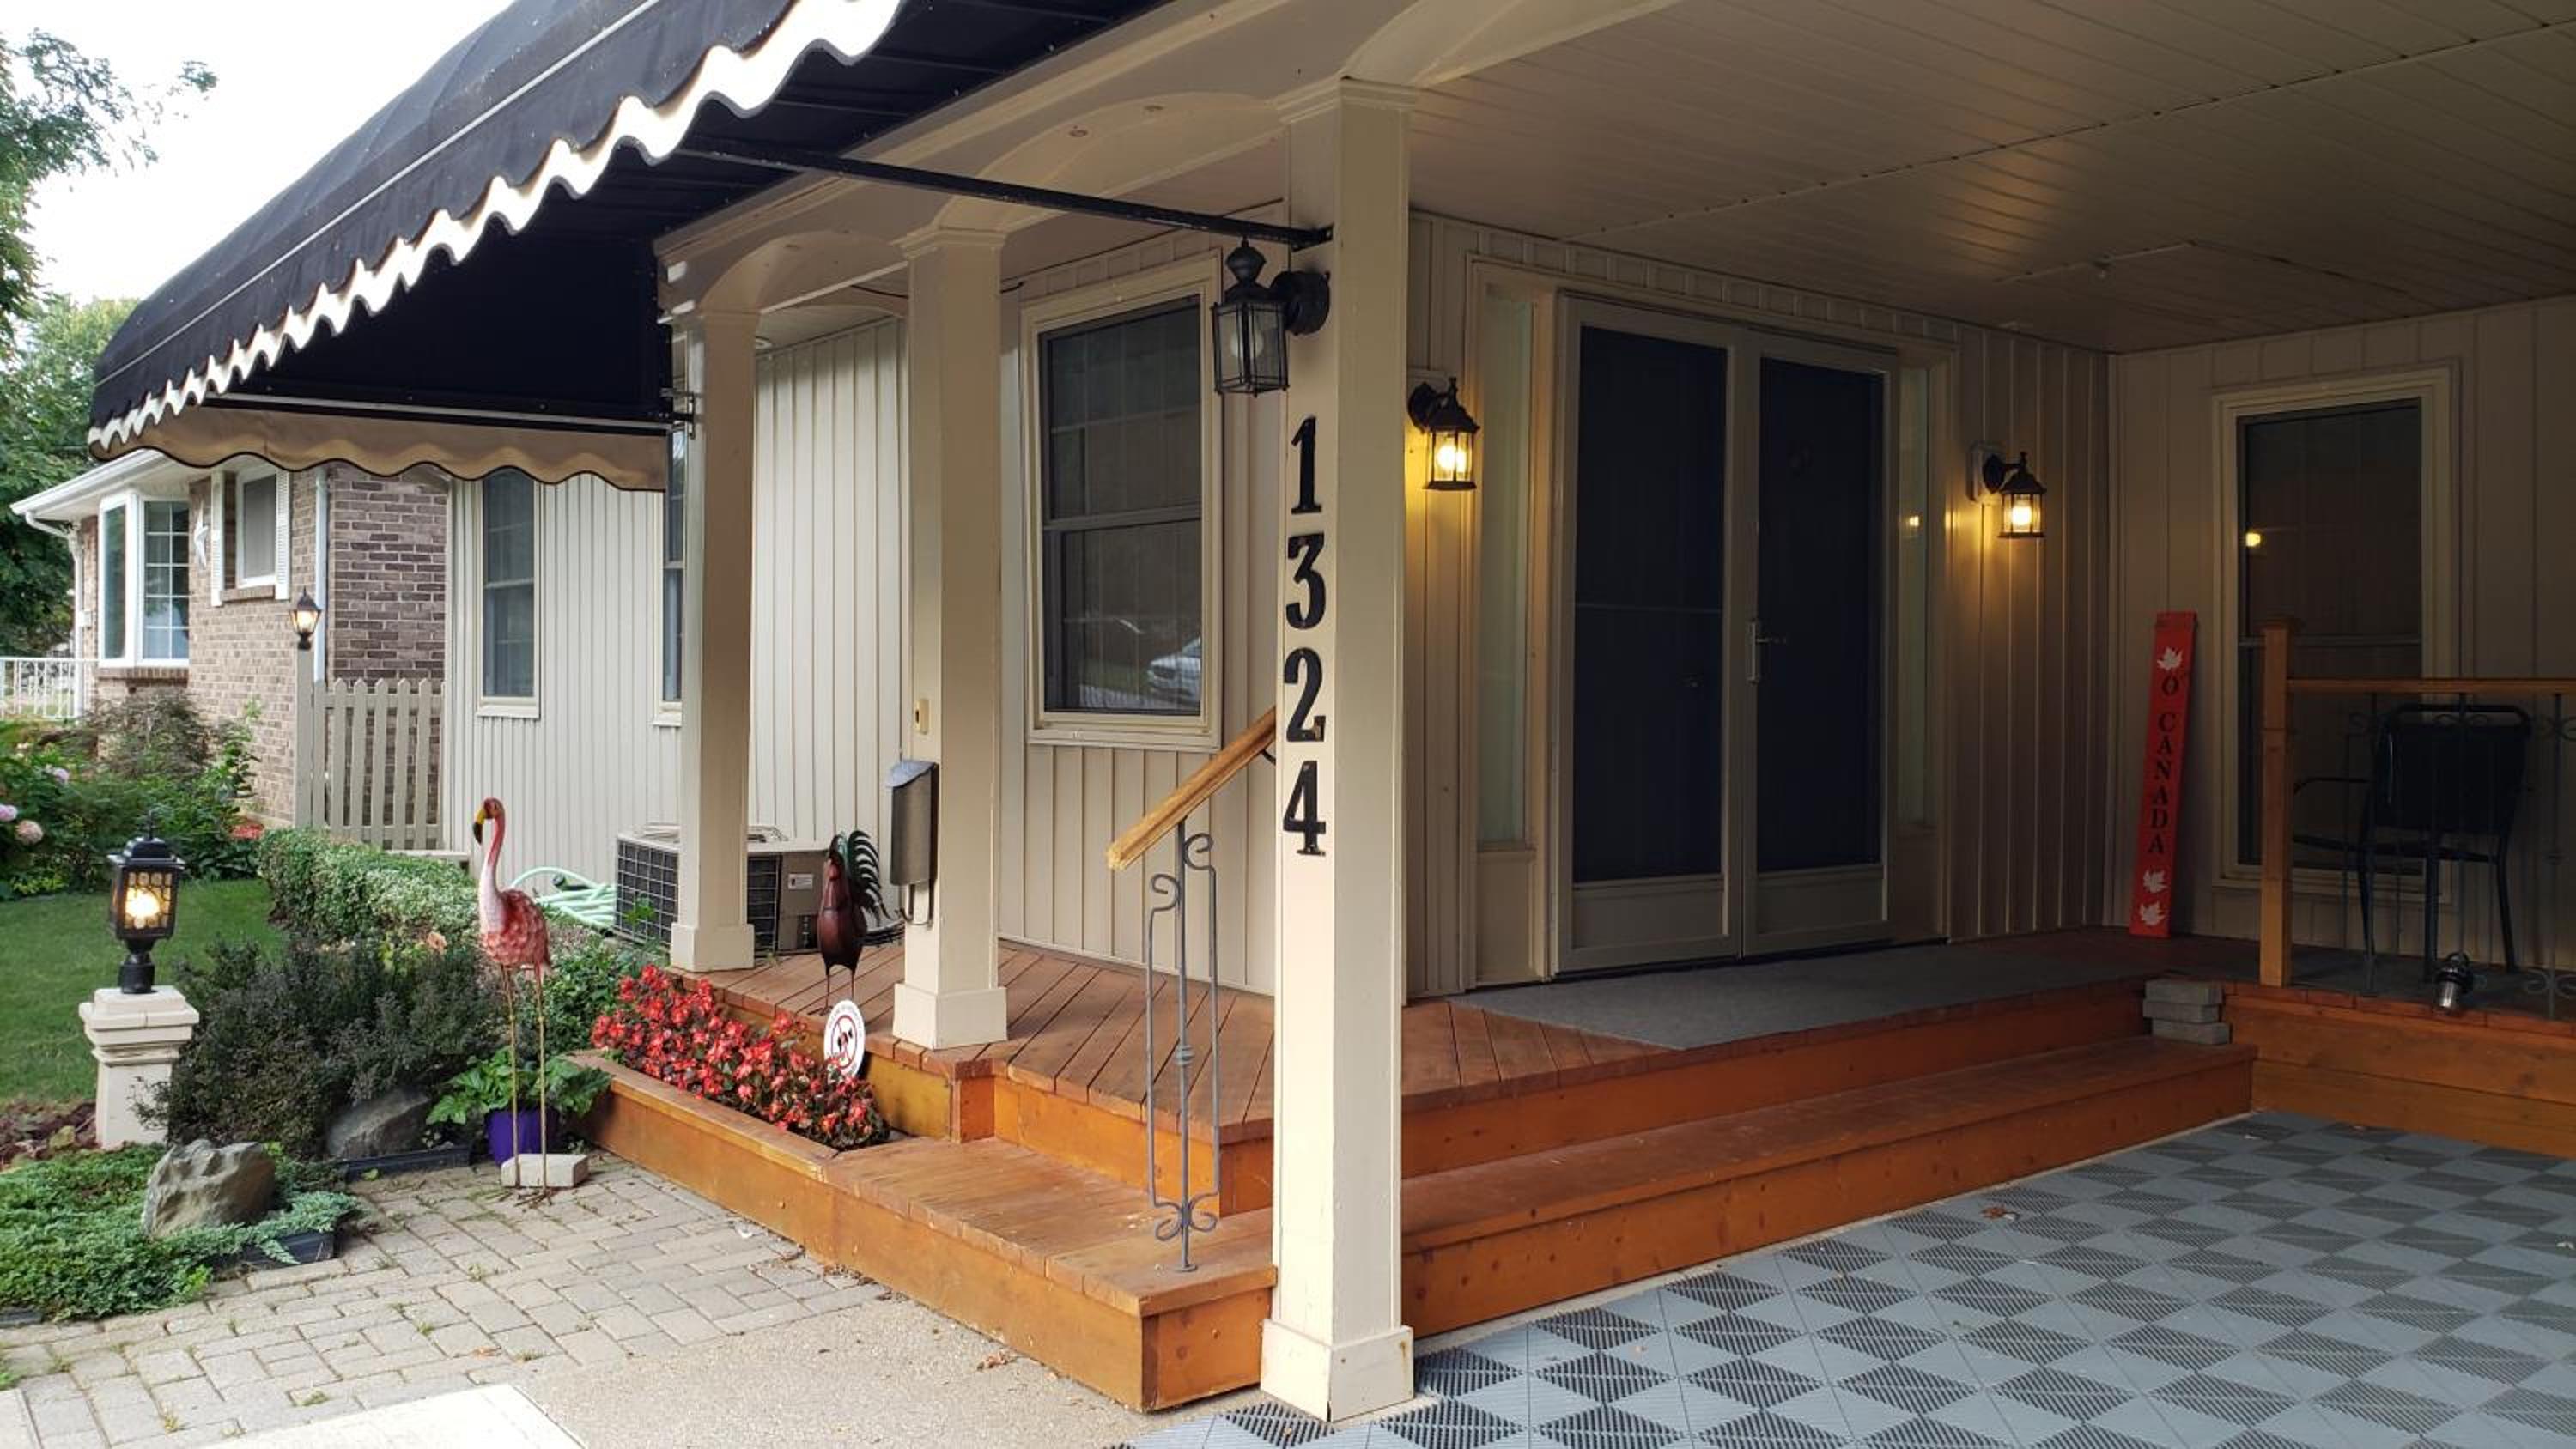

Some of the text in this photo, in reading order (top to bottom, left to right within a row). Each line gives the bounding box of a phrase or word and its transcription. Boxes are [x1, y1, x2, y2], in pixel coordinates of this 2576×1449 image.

[1283, 415, 1327, 856] 1324
[2148, 675, 2179, 854] O CANADA
